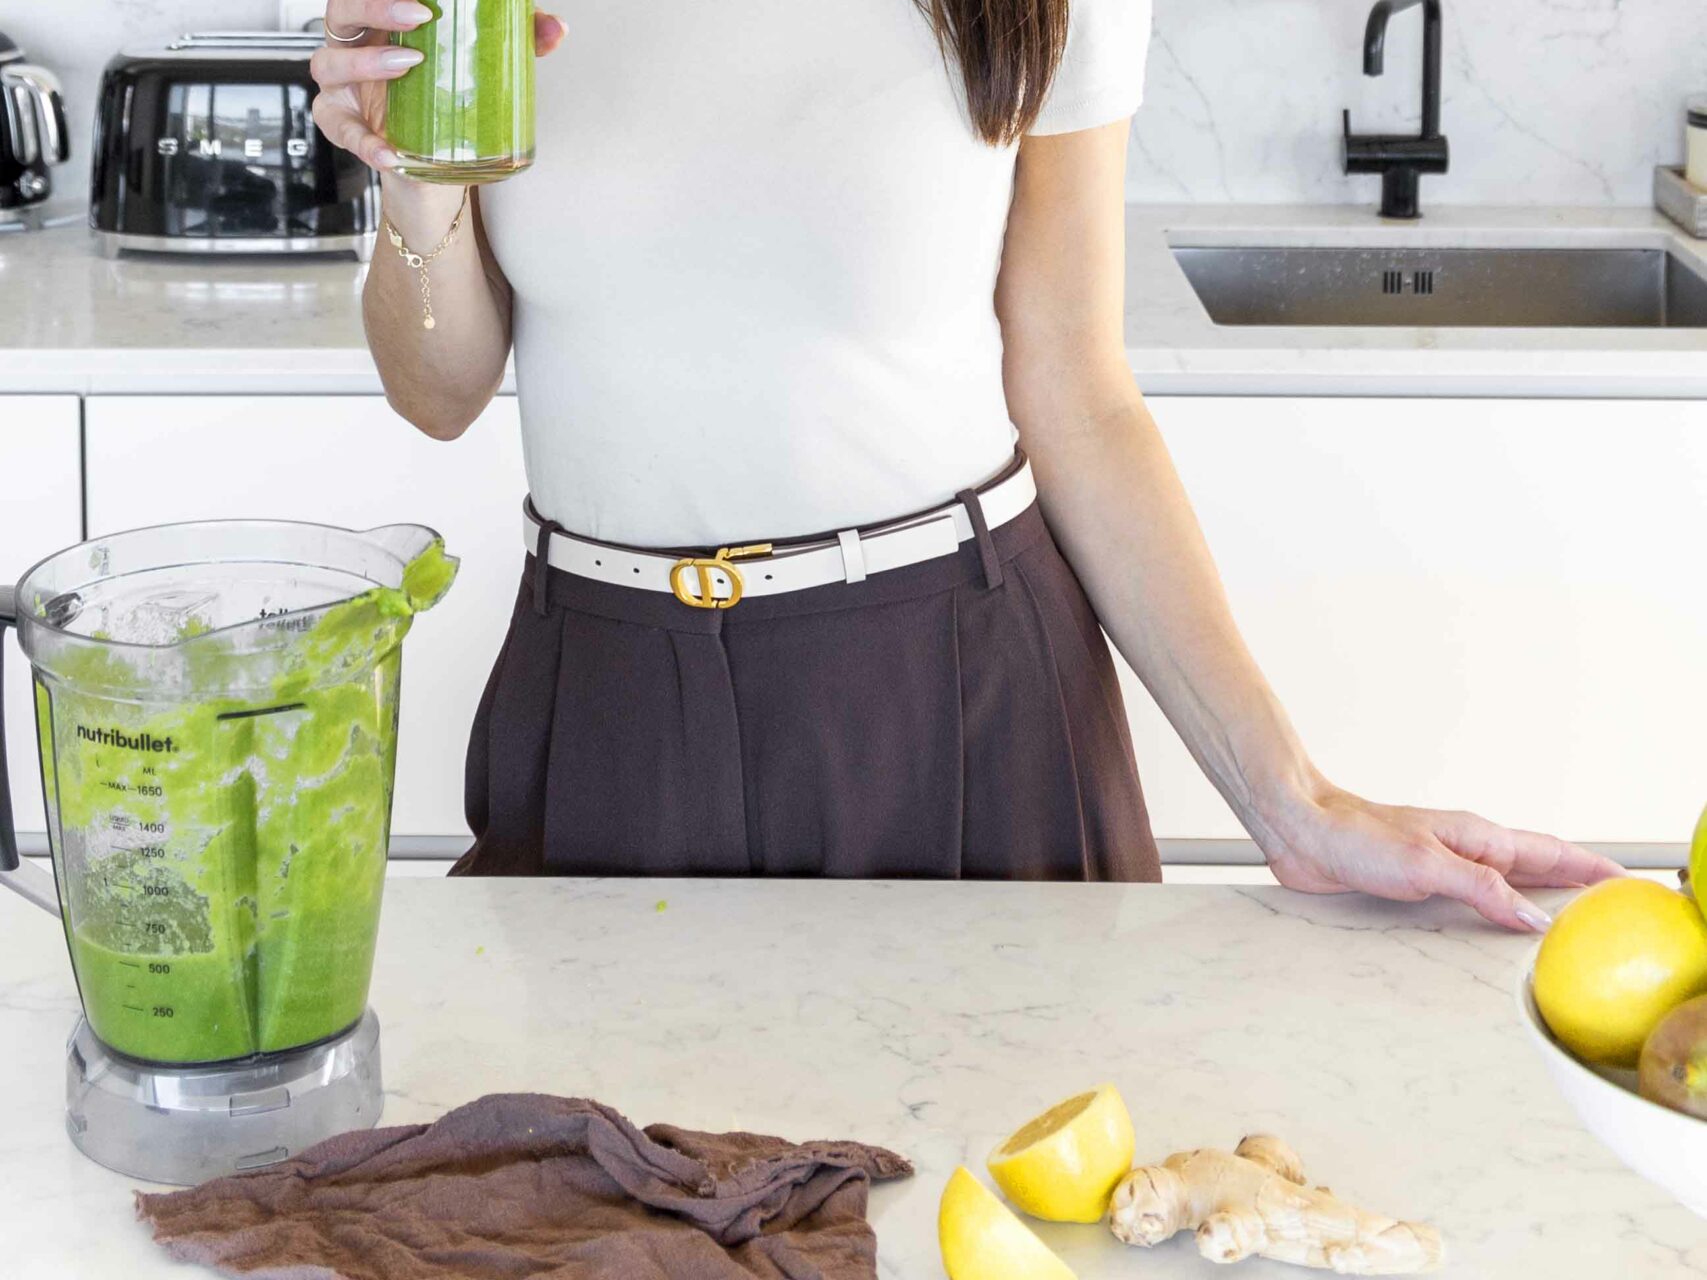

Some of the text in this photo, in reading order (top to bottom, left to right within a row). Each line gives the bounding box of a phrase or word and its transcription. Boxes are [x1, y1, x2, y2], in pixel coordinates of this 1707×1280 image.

[158, 138, 309, 157] SMEG
[77, 724, 173, 753] nutribullet
[107, 781, 163, 797] MAX 1650
[139, 822, 165, 833] 1400
[140, 847, 165, 858] 1250
[143, 884, 169, 896] 1000
[145, 923, 166, 934] 750
[148, 963, 170, 974] 500
[153, 1007, 174, 1018] 250
